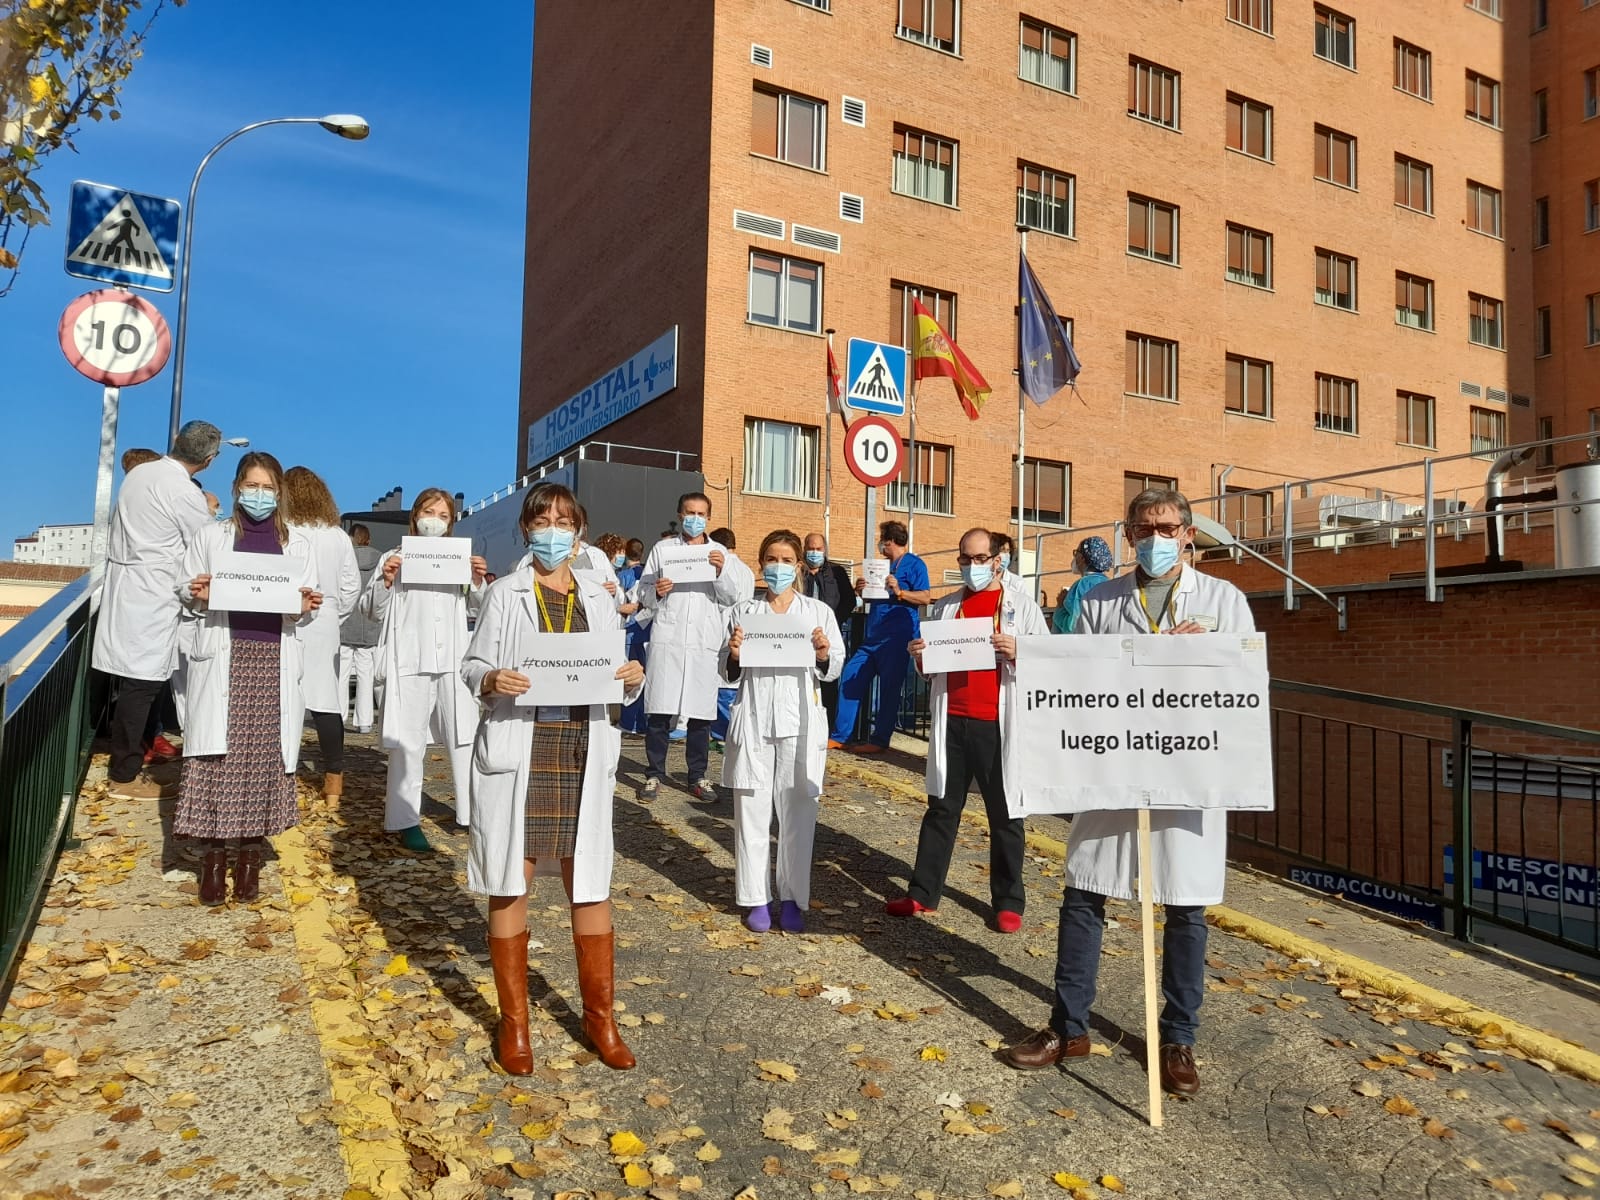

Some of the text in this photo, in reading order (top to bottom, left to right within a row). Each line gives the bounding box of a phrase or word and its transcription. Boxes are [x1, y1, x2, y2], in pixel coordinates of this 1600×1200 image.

[91, 320, 142, 354] 10
[545, 359, 641, 441] HOSPITAL
[574, 388, 641, 441] UNIVERSITARIO
[861, 438, 889, 464] 10
[404, 552, 462, 560] #CONSOLIDACIÓN
[215, 571, 290, 583] #CONSOLIDACIÓN
[744, 632, 805, 640] #CONSOLIDACIÓN
[522, 657, 611, 669] #CONSOLIDACIÓN
[566, 674, 579, 682] YA
[1026, 688, 1260, 711] ¡Primero el decretazo
[1061, 730, 1219, 755] luego latigazo!
